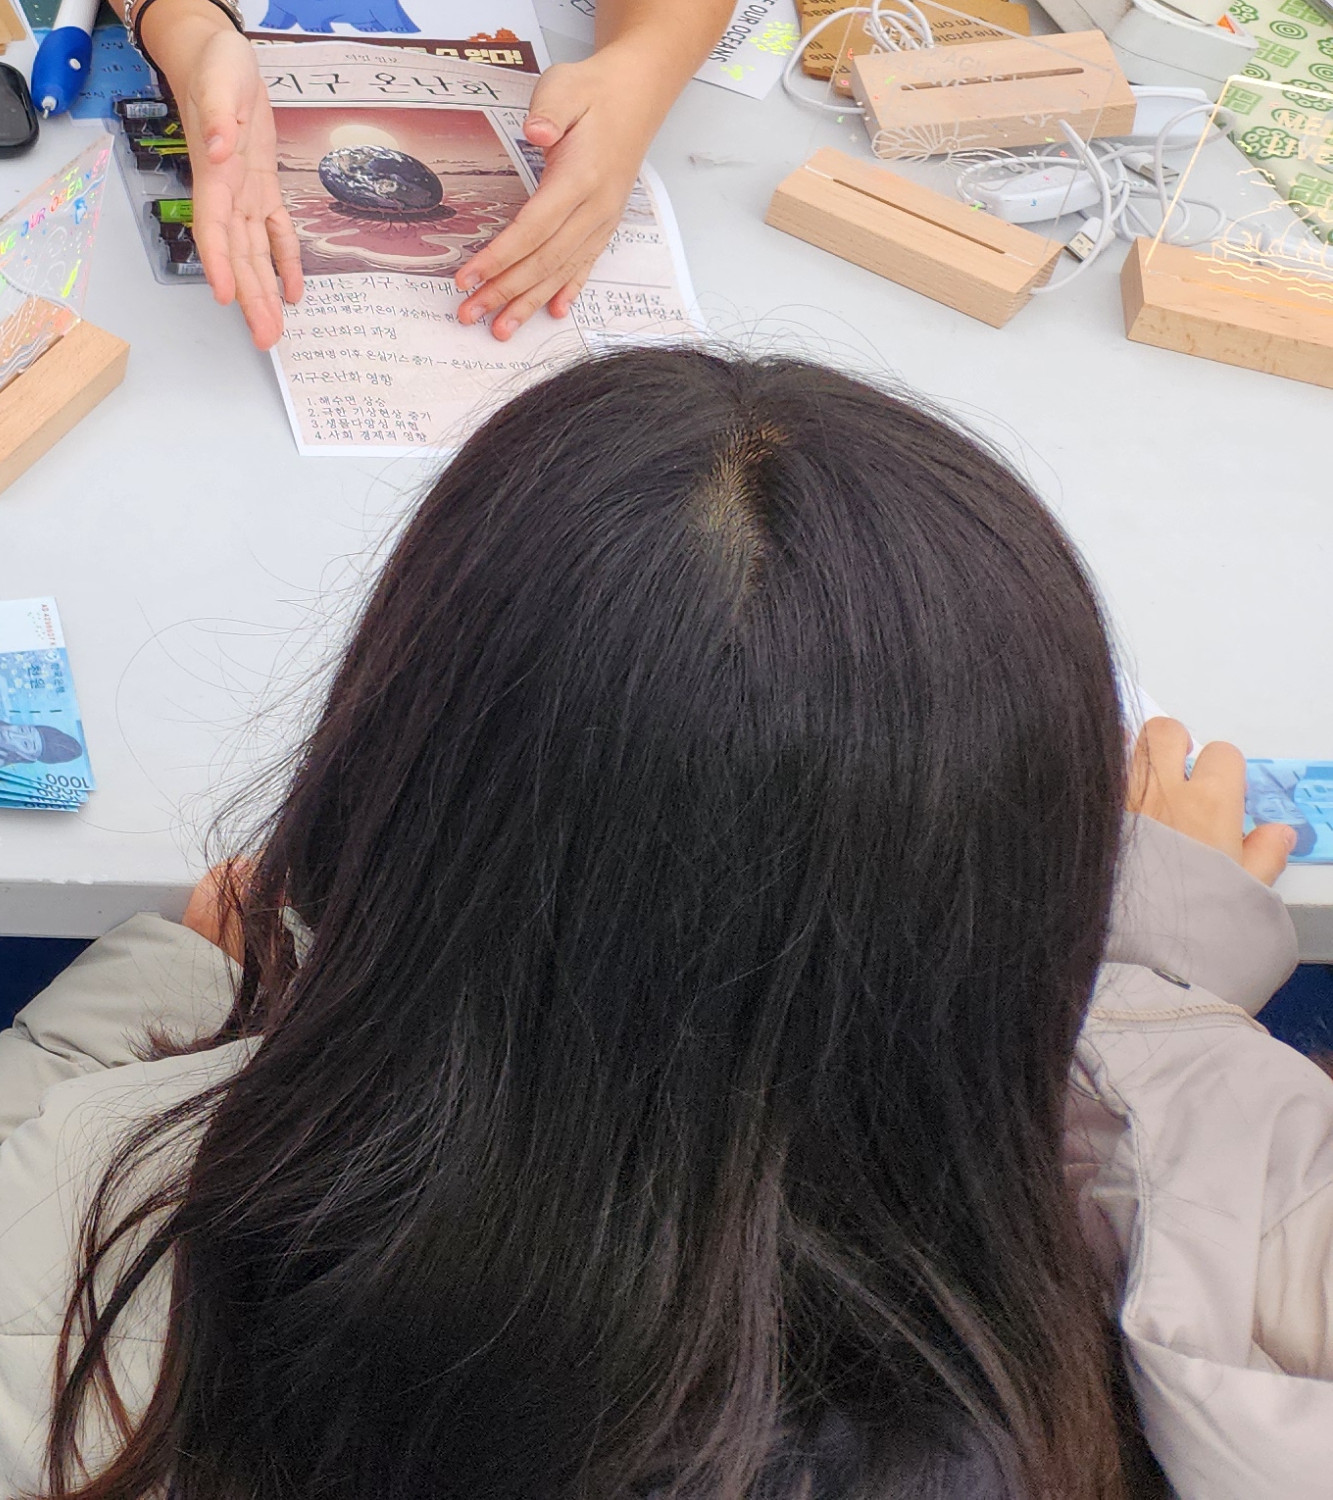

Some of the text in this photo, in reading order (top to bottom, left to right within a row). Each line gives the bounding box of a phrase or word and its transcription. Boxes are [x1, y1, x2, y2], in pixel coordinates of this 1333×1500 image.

[737, 4, 769, 25] OUR
[708, 24, 752, 63] OCEANS
[264, 71, 502, 101] 지구 온난화
[304, 291, 368, 306] 온난화란?
[312, 325, 367, 340] 온난화의
[339, 349, 363, 359] 이후
[366, 350, 410, 363] 온실가스
[412, 354, 433, 367] 증가
[362, 395, 386, 408] 상승
[45, 773, 90, 789] 1000
